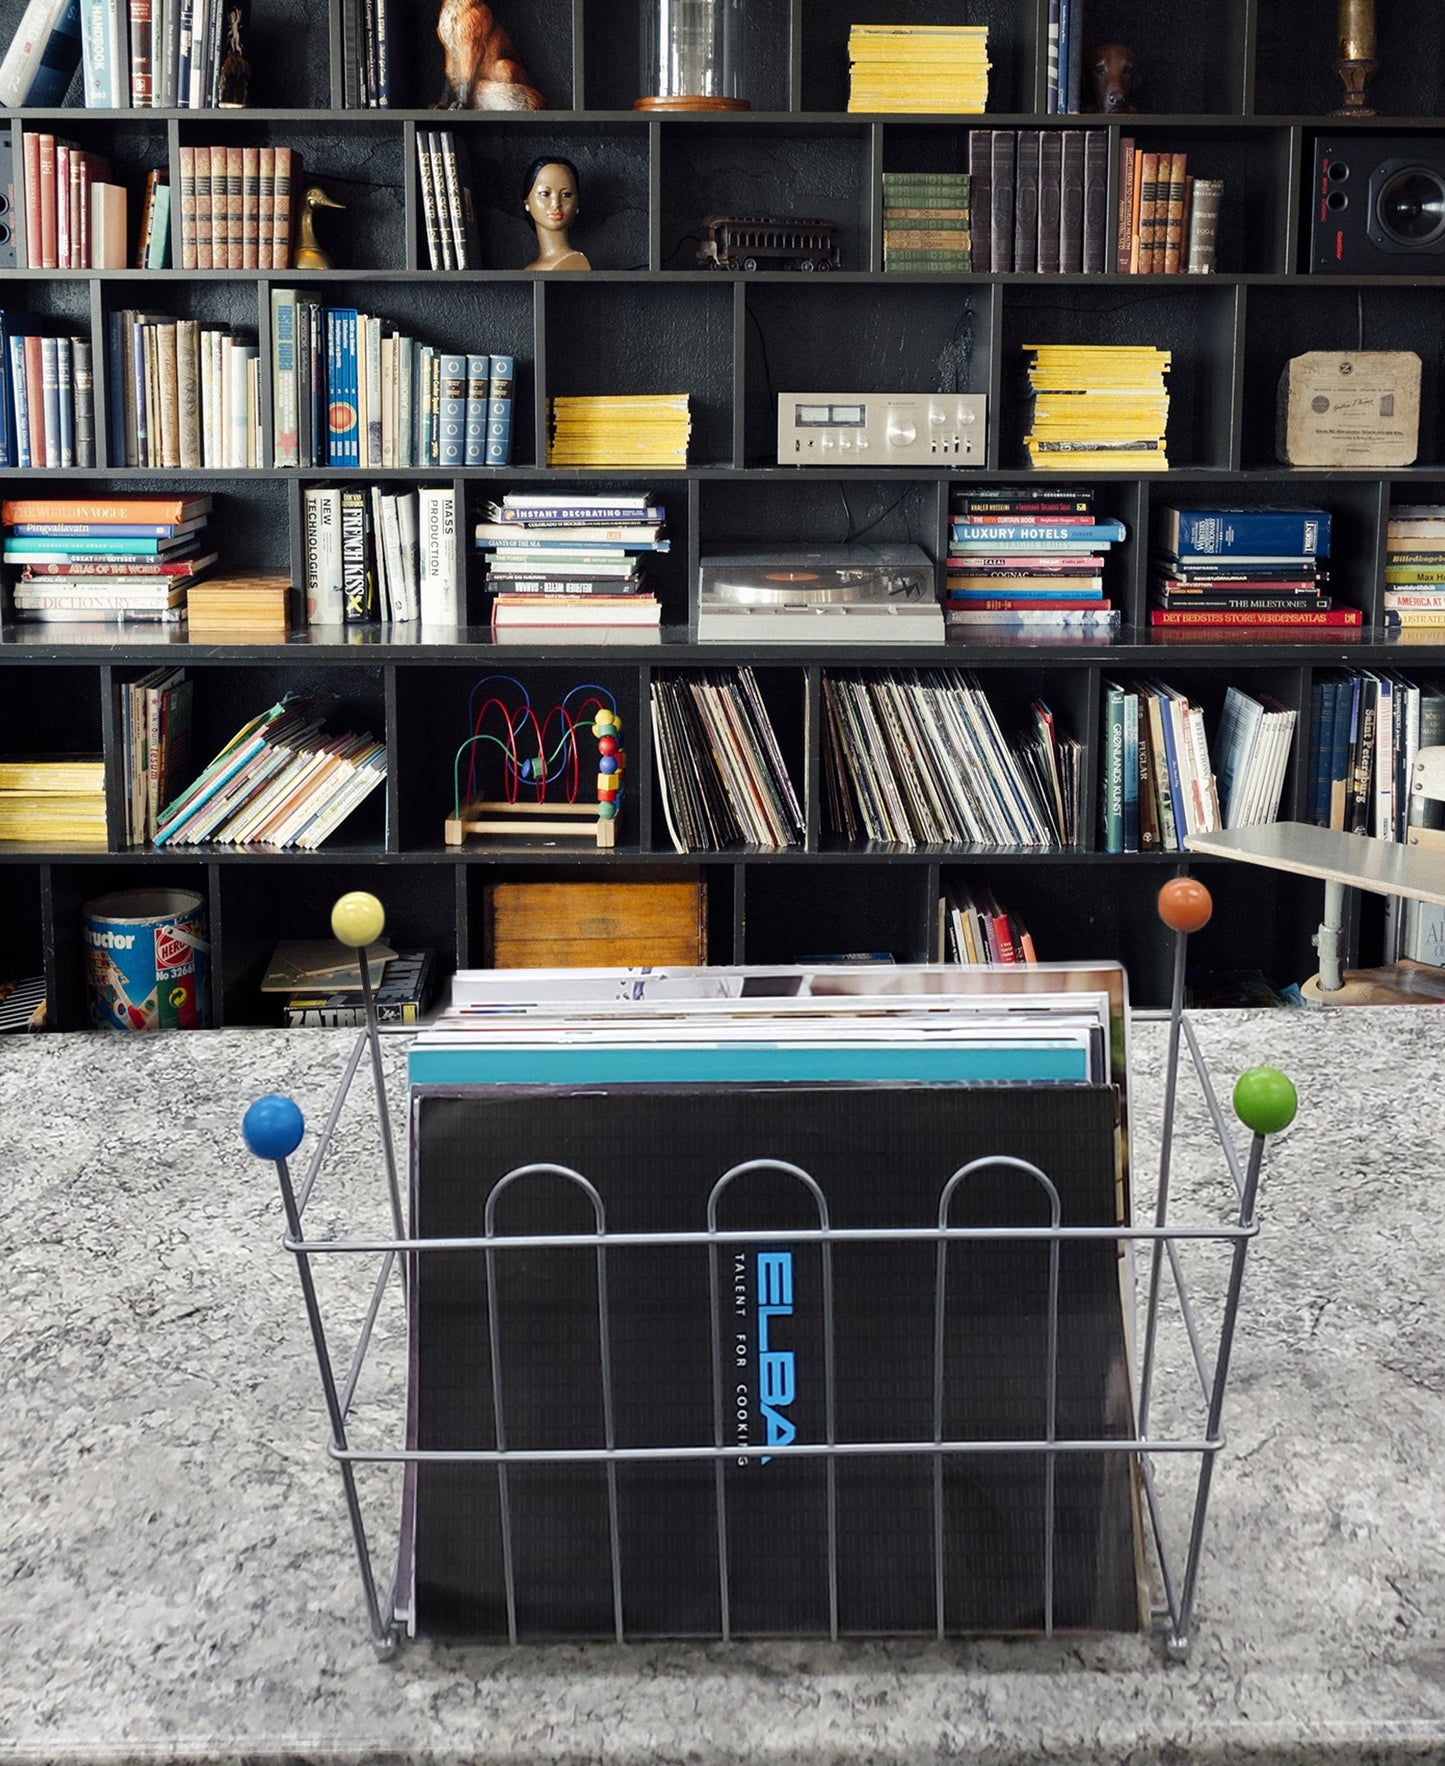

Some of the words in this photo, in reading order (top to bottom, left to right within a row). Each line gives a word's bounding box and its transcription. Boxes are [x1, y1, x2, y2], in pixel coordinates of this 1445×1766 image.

[92, 6, 104, 71] HANDBOOK
[37, 508, 76, 518] WORLD
[77, 508, 89, 518] IN
[91, 508, 127, 519] VOGUE
[323, 499, 332, 525] NEW
[444, 500, 453, 535] MASS
[516, 508, 558, 518] INSTANT
[563, 509, 621, 518] DECORATING
[308, 498, 318, 589] TECHNOLOGIES
[343, 508, 364, 561] FRENCH
[430, 500, 439, 577] PRODUCTION
[964, 529, 1015, 538] LUXURY
[1021, 529, 1068, 538] HOTELS
[69, 565, 94, 574] ATLAS
[96, 565, 109, 574] OF
[111, 565, 127, 574] THE
[128, 565, 161, 574] WORLD
[107, 555, 137, 563] ODYSSEY
[344, 564, 364, 595] KISS
[44, 597, 131, 609] DICTIONARY
[1229, 600, 1249, 608] THE
[1250, 600, 1307, 608] MILESTONES
[1397, 597, 1432, 606] AMERICA
[1433, 597, 1442, 606] AT
[1163, 614, 1181, 622] DET
[1183, 613, 1223, 622] BEDSTES
[1225, 614, 1256, 622] STORE
[1258, 614, 1327, 623] VERDENSATLAS
[1363, 709, 1374, 738] Saint
[1380, 700, 1391, 730] GUINNESS
[1113, 724, 1122, 784] GRØNLANDS
[1195, 722, 1209, 778] REFLECTIONS
[1380, 731, 1391, 748] BOOK
[1380, 749, 1391, 758] OF
[150, 749, 159, 780] lesum
[1139, 740, 1148, 780] FUGLAR
[1356, 741, 1374, 804] Petersburg
[1380, 760, 1391, 789] RECORDS
[1113, 786, 1121, 818] KUNST
[156, 971, 169, 981] No
[171, 964, 196, 978] 32661
[735, 1253, 746, 1316] TALENT
[736, 1335, 746, 1366] FOR
[757, 1252, 796, 1465] ELBA
